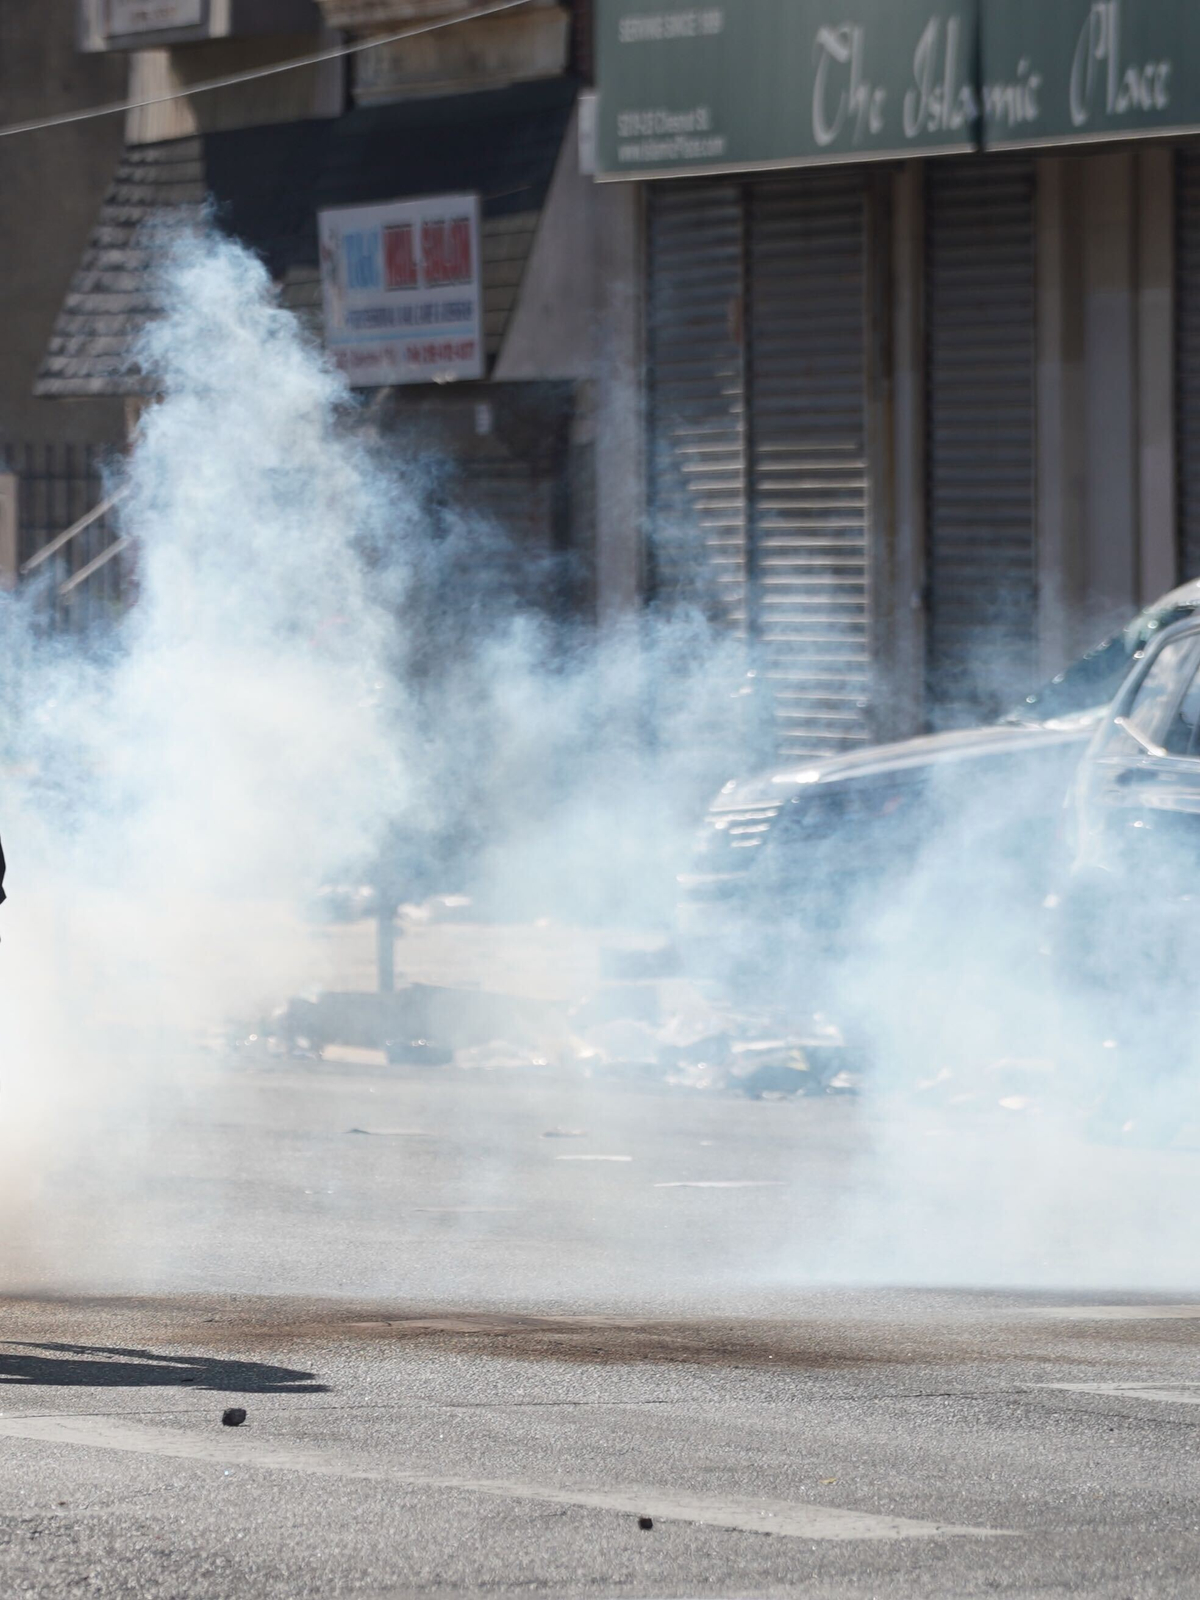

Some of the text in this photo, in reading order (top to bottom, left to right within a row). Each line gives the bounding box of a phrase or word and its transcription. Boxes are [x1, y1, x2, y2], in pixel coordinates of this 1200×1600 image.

[812, 0, 1171, 146] The Islamic Place
